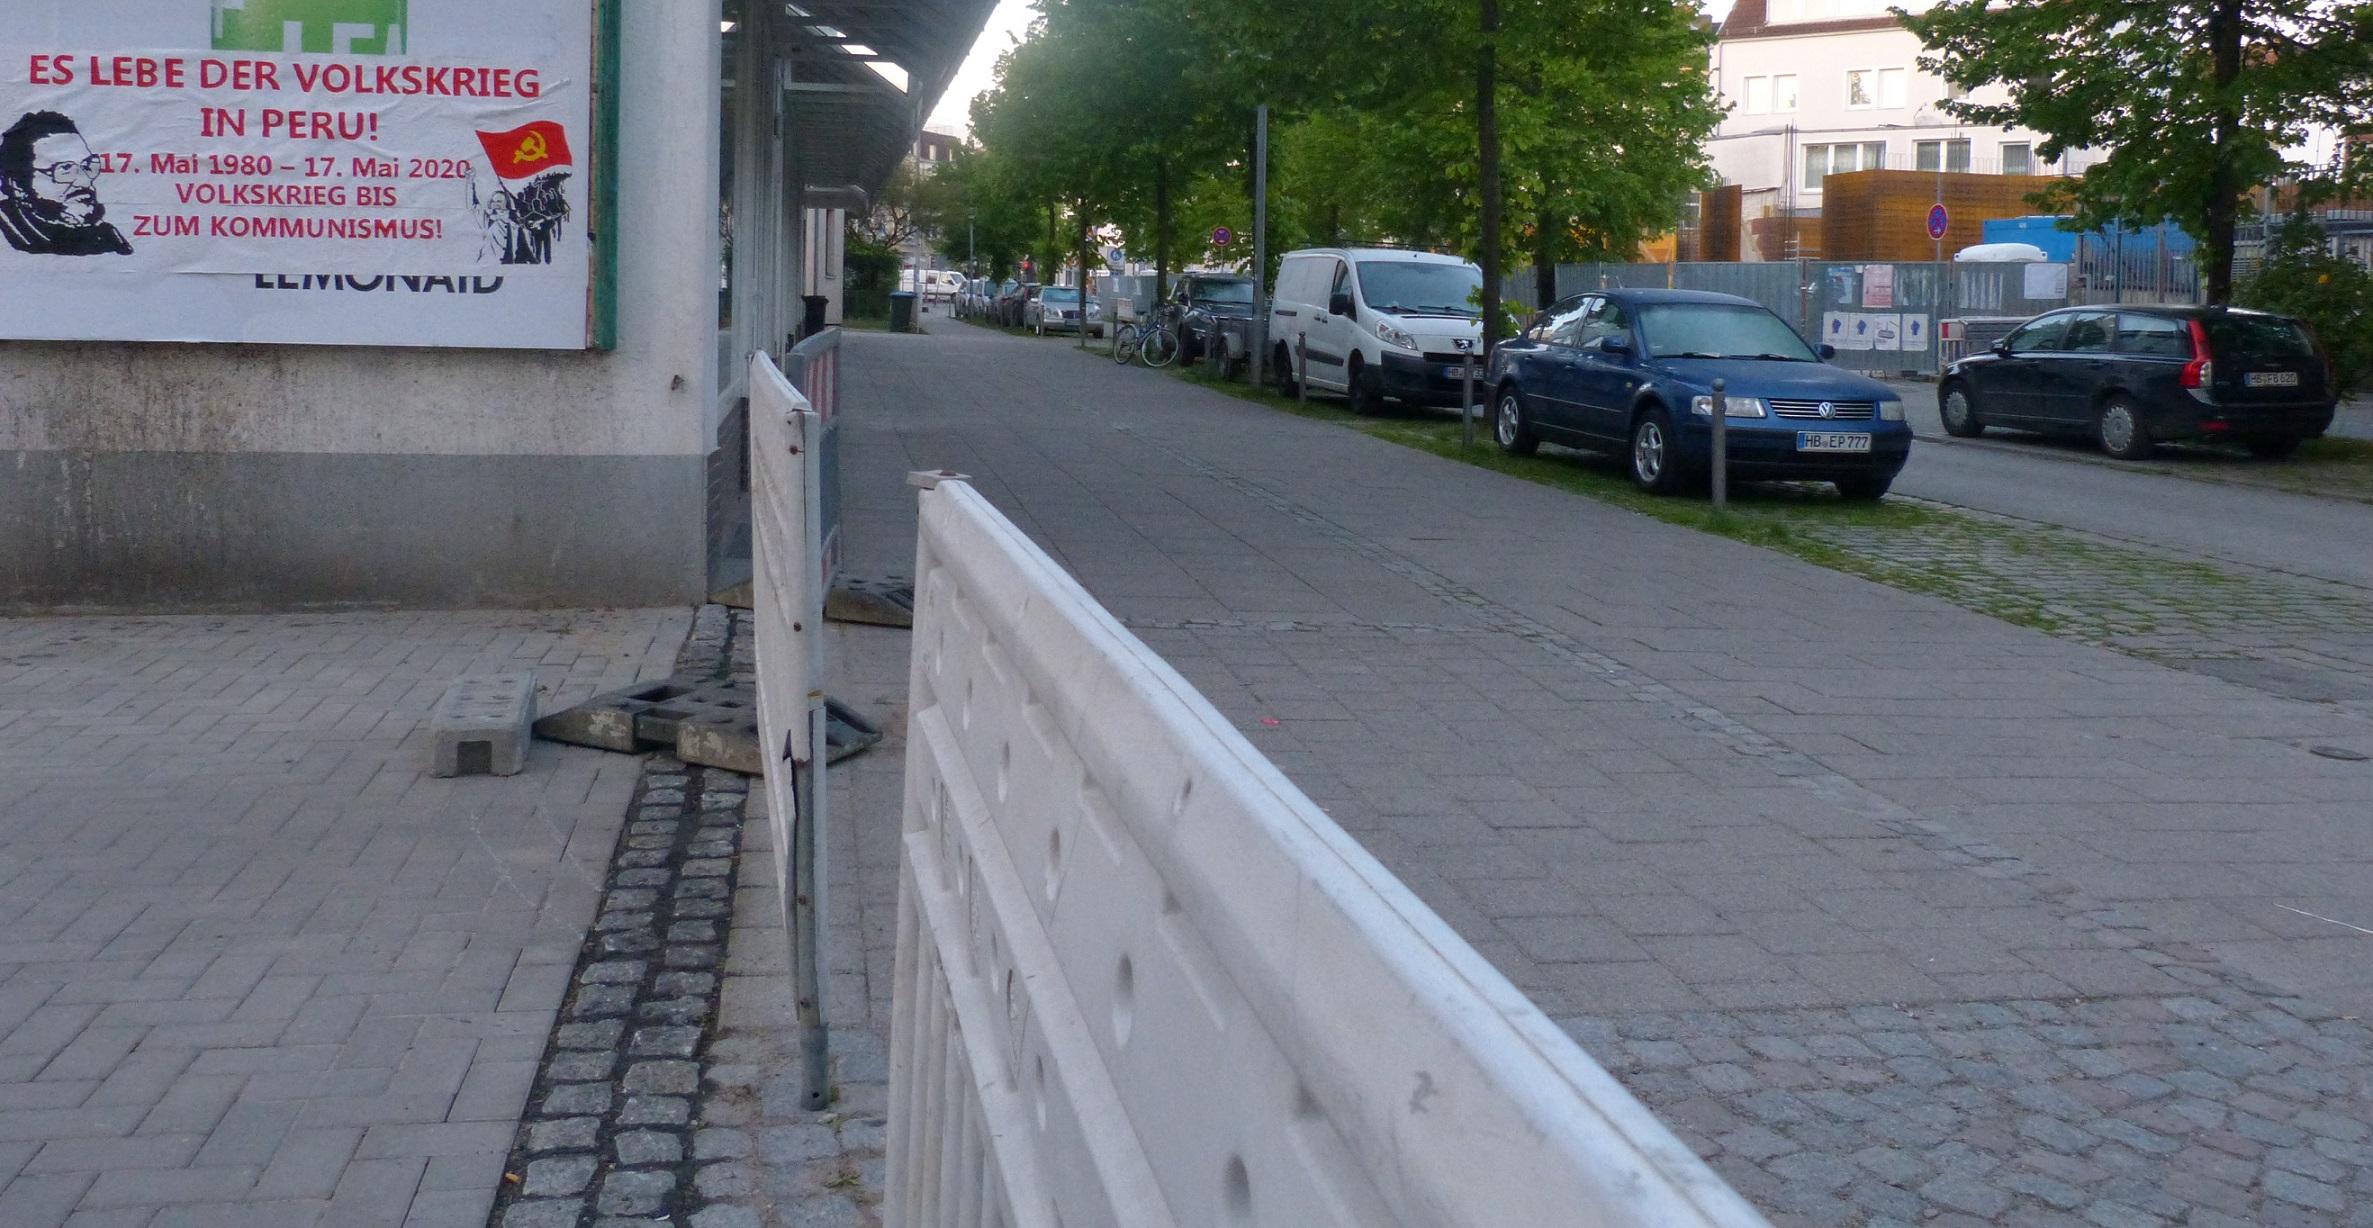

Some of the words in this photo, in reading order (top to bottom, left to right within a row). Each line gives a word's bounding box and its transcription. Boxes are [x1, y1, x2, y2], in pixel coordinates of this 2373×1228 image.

[29, 53, 75, 86] ES
[89, 55, 185, 89] LEBE
[199, 59, 281, 91] DER
[292, 63, 541, 99] VOLKSKRIEG
[200, 107, 246, 138] IN
[261, 109, 378, 141] PERU!
[100, 152, 140, 174] 17.
[150, 153, 199, 175] Mai
[208, 154, 273, 176] 1980
[304, 156, 342, 178] 17.
[352, 157, 400, 178] Mai
[408, 158, 471, 179] 2020
[175, 183, 347, 206] VOLKSKRIEG
[356, 186, 398, 207] BIS
[133, 215, 200, 237] ZUM
[210, 215, 443, 240] KOMMUNISMUS!
[1805, 435, 1820, 448] HB
[1829, 435, 1846, 448] EP
[1847, 436, 1868, 449] 777
